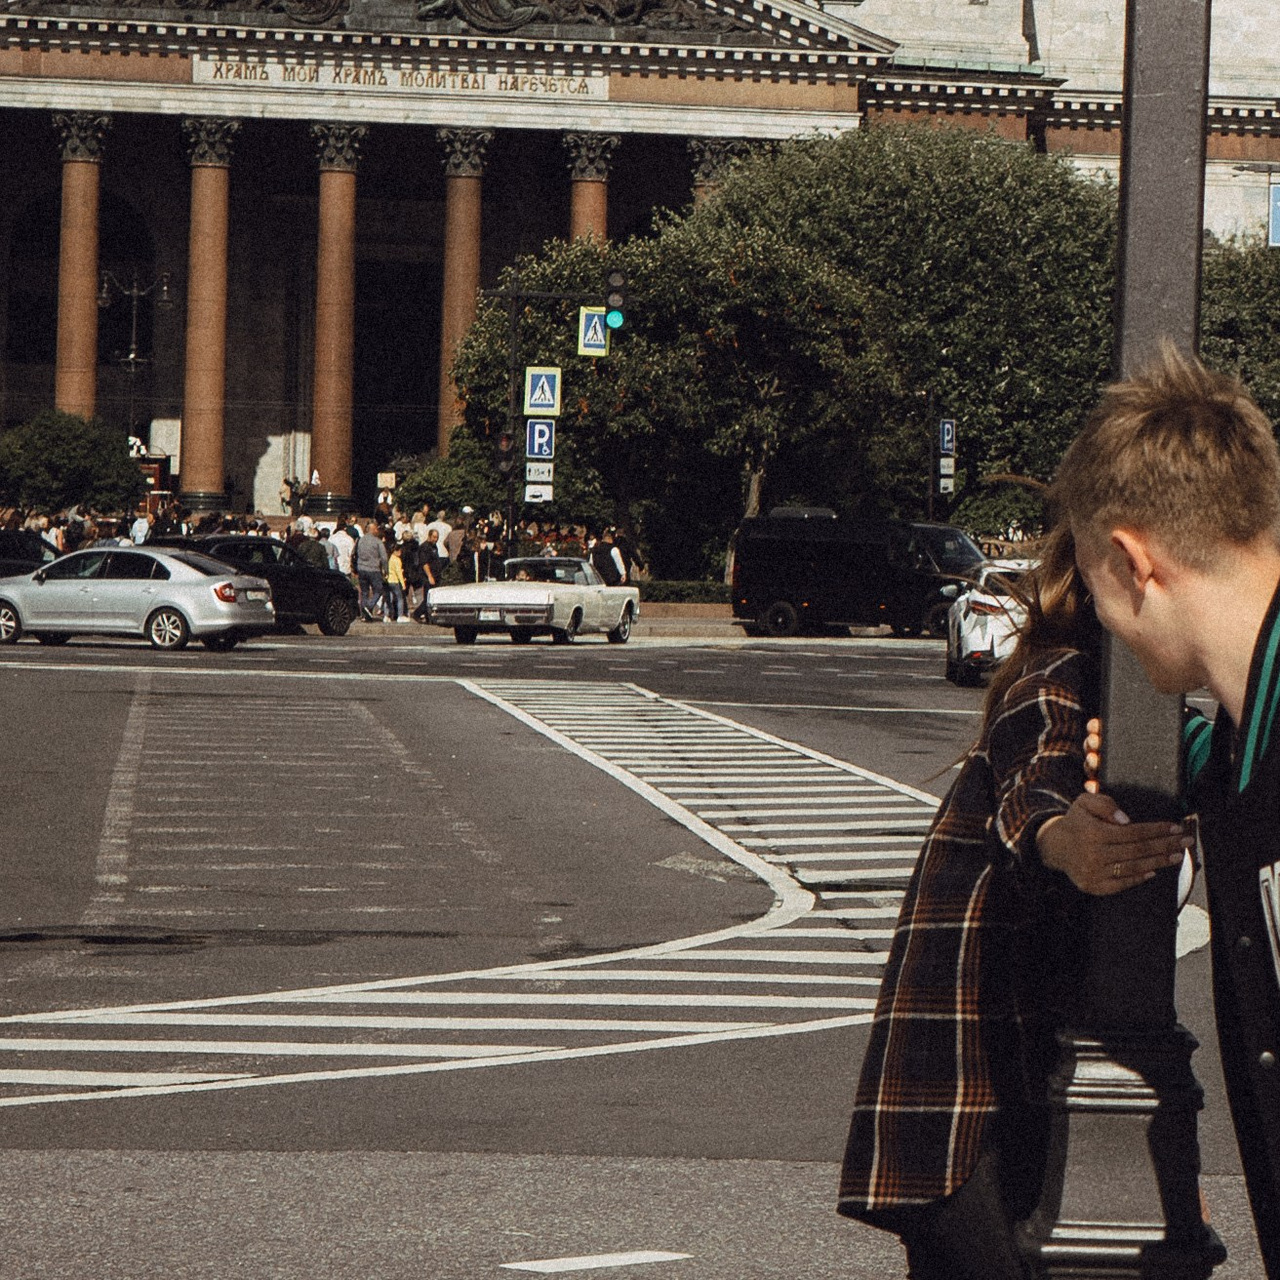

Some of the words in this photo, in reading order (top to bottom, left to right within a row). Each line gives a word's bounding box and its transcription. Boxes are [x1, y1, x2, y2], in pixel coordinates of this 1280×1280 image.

[212, 62, 270, 81] ХРАМЪ
[332, 66, 388, 86] ХРАМЪ
[400, 70, 486, 90] МОЛИТВЫ
